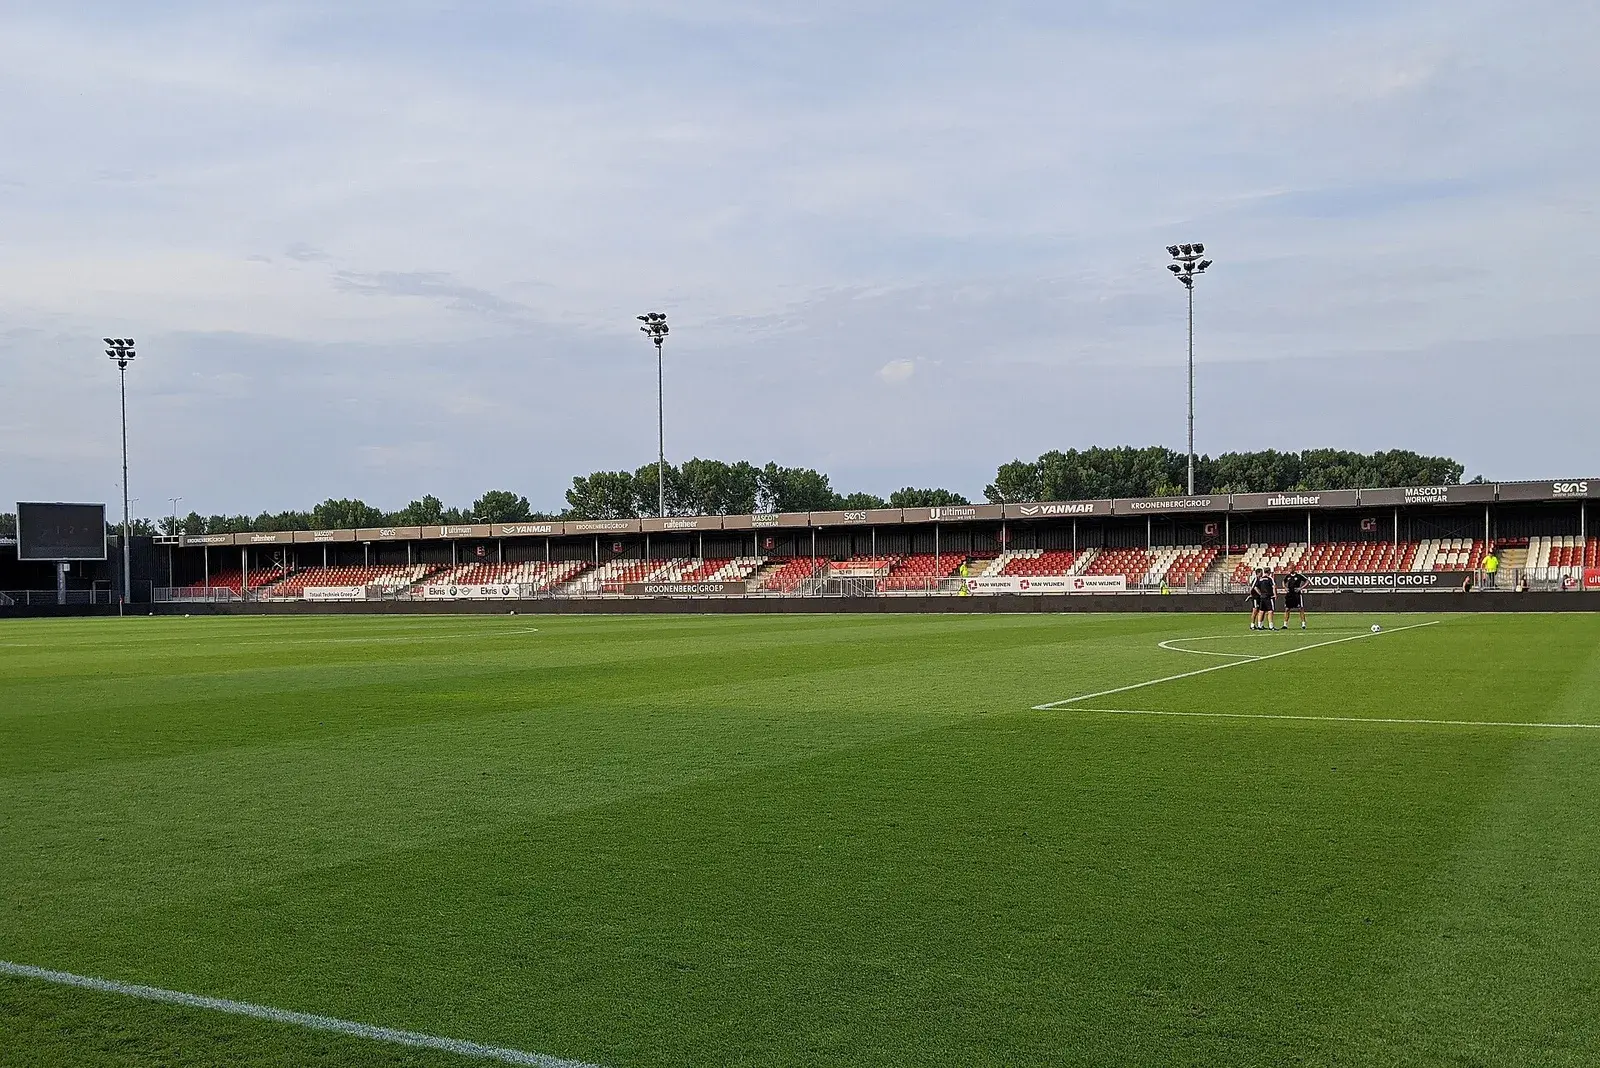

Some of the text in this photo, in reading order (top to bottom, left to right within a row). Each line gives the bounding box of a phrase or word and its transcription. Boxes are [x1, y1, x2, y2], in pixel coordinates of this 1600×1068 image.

[1552, 481, 1588, 493] sens
[1267, 493, 1320, 506] ruitenheer
[1404, 495, 1448, 503] WORKWEAR
[941, 507, 976, 516] ultimum
[1040, 504, 1094, 514] YANMAR
[516, 525, 552, 533] YANMAR
[428, 587, 446, 596] Ekris
[480, 587, 498, 595] Ekris
